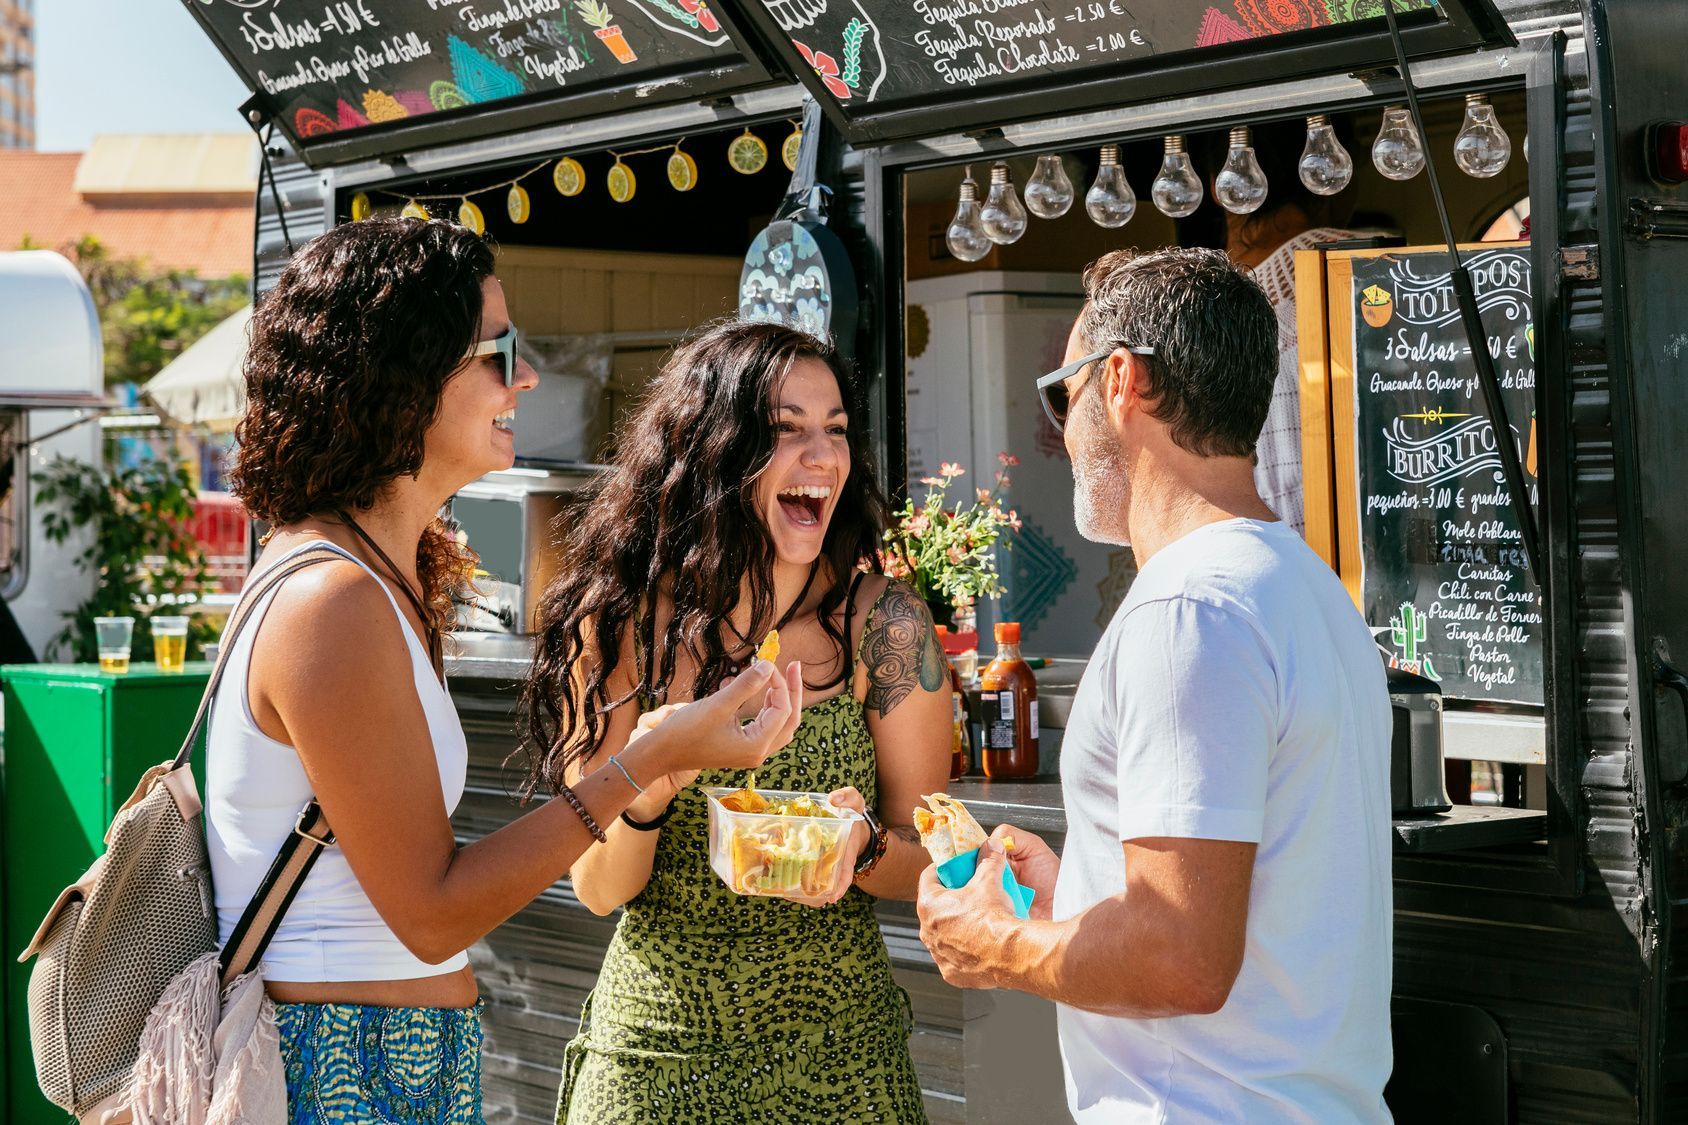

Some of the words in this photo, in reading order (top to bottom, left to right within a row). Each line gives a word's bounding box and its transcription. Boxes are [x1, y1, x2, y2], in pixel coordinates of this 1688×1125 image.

[913, 0, 982, 28] Tequila
[243, 11, 321, 50] Salsas
[914, 24, 982, 60] Tequila
[975, 8, 1056, 48] Reposado
[524, 45, 585, 86] Vegetal
[933, 52, 1001, 86] Tequila
[997, 38, 1080, 73] Chocolate
[1129, 29, 1145, 46] €
[1402, 258, 1522, 319] TOTPOS
[1384, 337, 1394, 360] 3
[1395, 327, 1459, 362] Salsas
[1505, 335, 1517, 359] €
[1426, 370, 1463, 395] Queso
[1501, 369, 1514, 389] de
[1515, 368, 1535, 390] Gall
[1393, 424, 1498, 479] BURRITO
[1455, 487, 1465, 508] €
[1471, 485, 1512, 514] grandes
[1442, 520, 1476, 541] Mole
[1477, 520, 1521, 539] Poblan
[1458, 562, 1513, 581] Carnitas
[1438, 580, 1472, 600] Chili
[1474, 589, 1494, 600] con
[1494, 584, 1534, 603] Carne
[1428, 601, 1484, 620] Picadillo
[1485, 605, 1499, 621] de
[1445, 622, 1481, 649] Tinga
[1481, 624, 1495, 642] de
[1495, 624, 1531, 643] Pollo
[1469, 643, 1512, 664] Pastor
[1467, 663, 1516, 691] Vegetal
